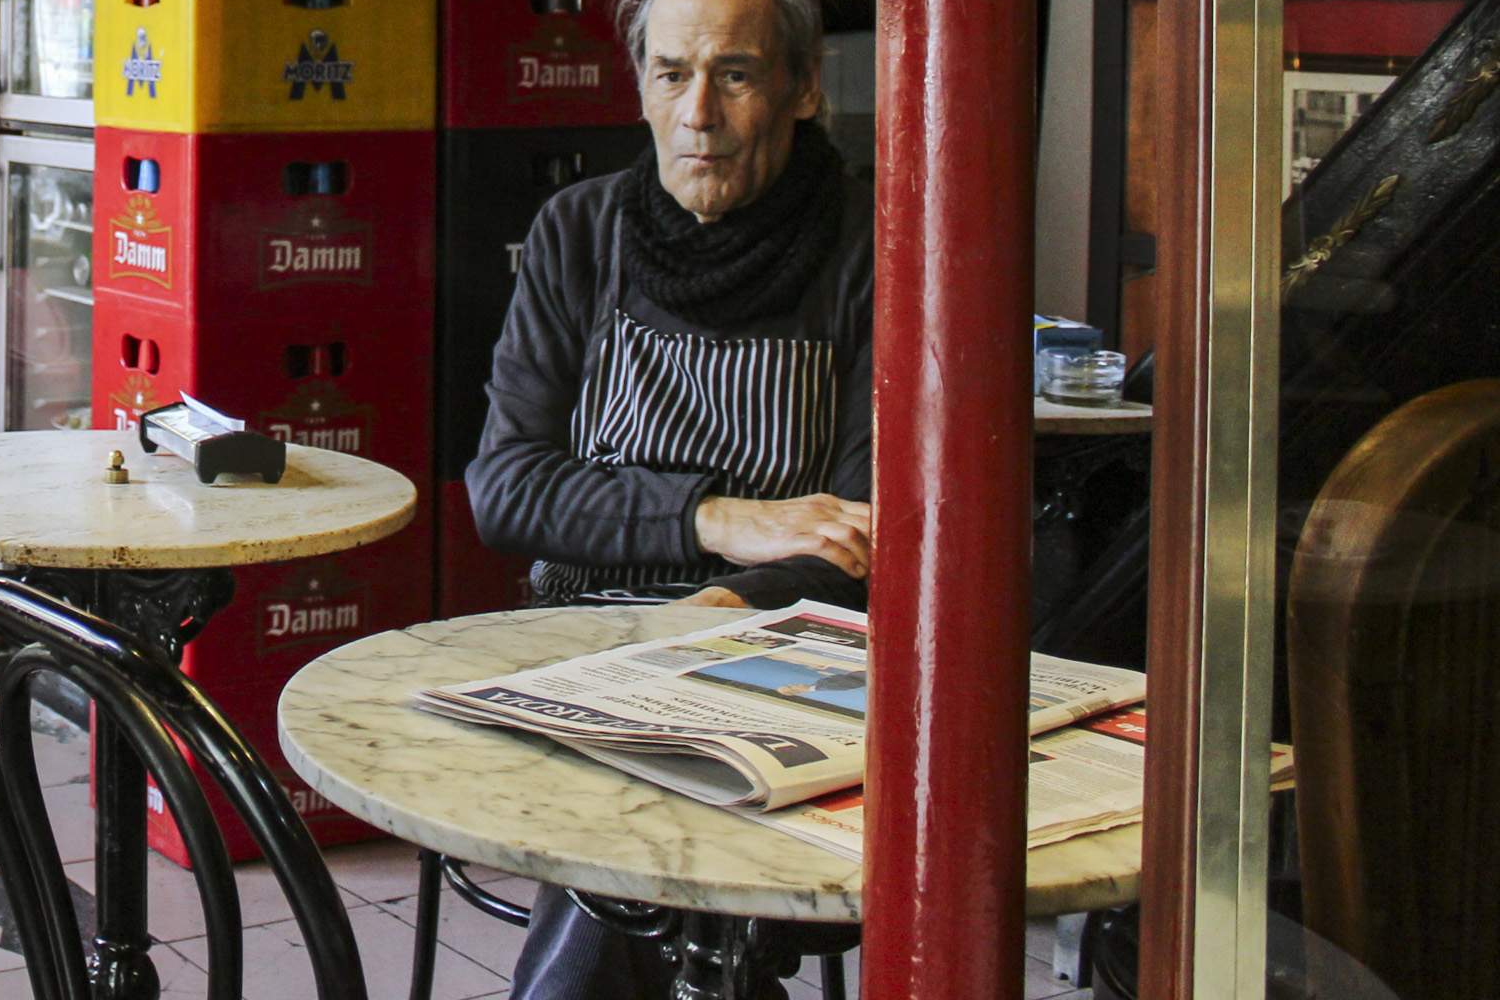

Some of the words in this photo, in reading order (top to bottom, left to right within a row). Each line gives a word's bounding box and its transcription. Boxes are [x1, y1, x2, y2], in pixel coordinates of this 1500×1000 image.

[284, 60, 355, 83] MORITZ
[517, 56, 600, 89] Damm
[114, 231, 167, 273] Damm
[269, 239, 362, 272] Damm
[266, 603, 359, 637] Damm
